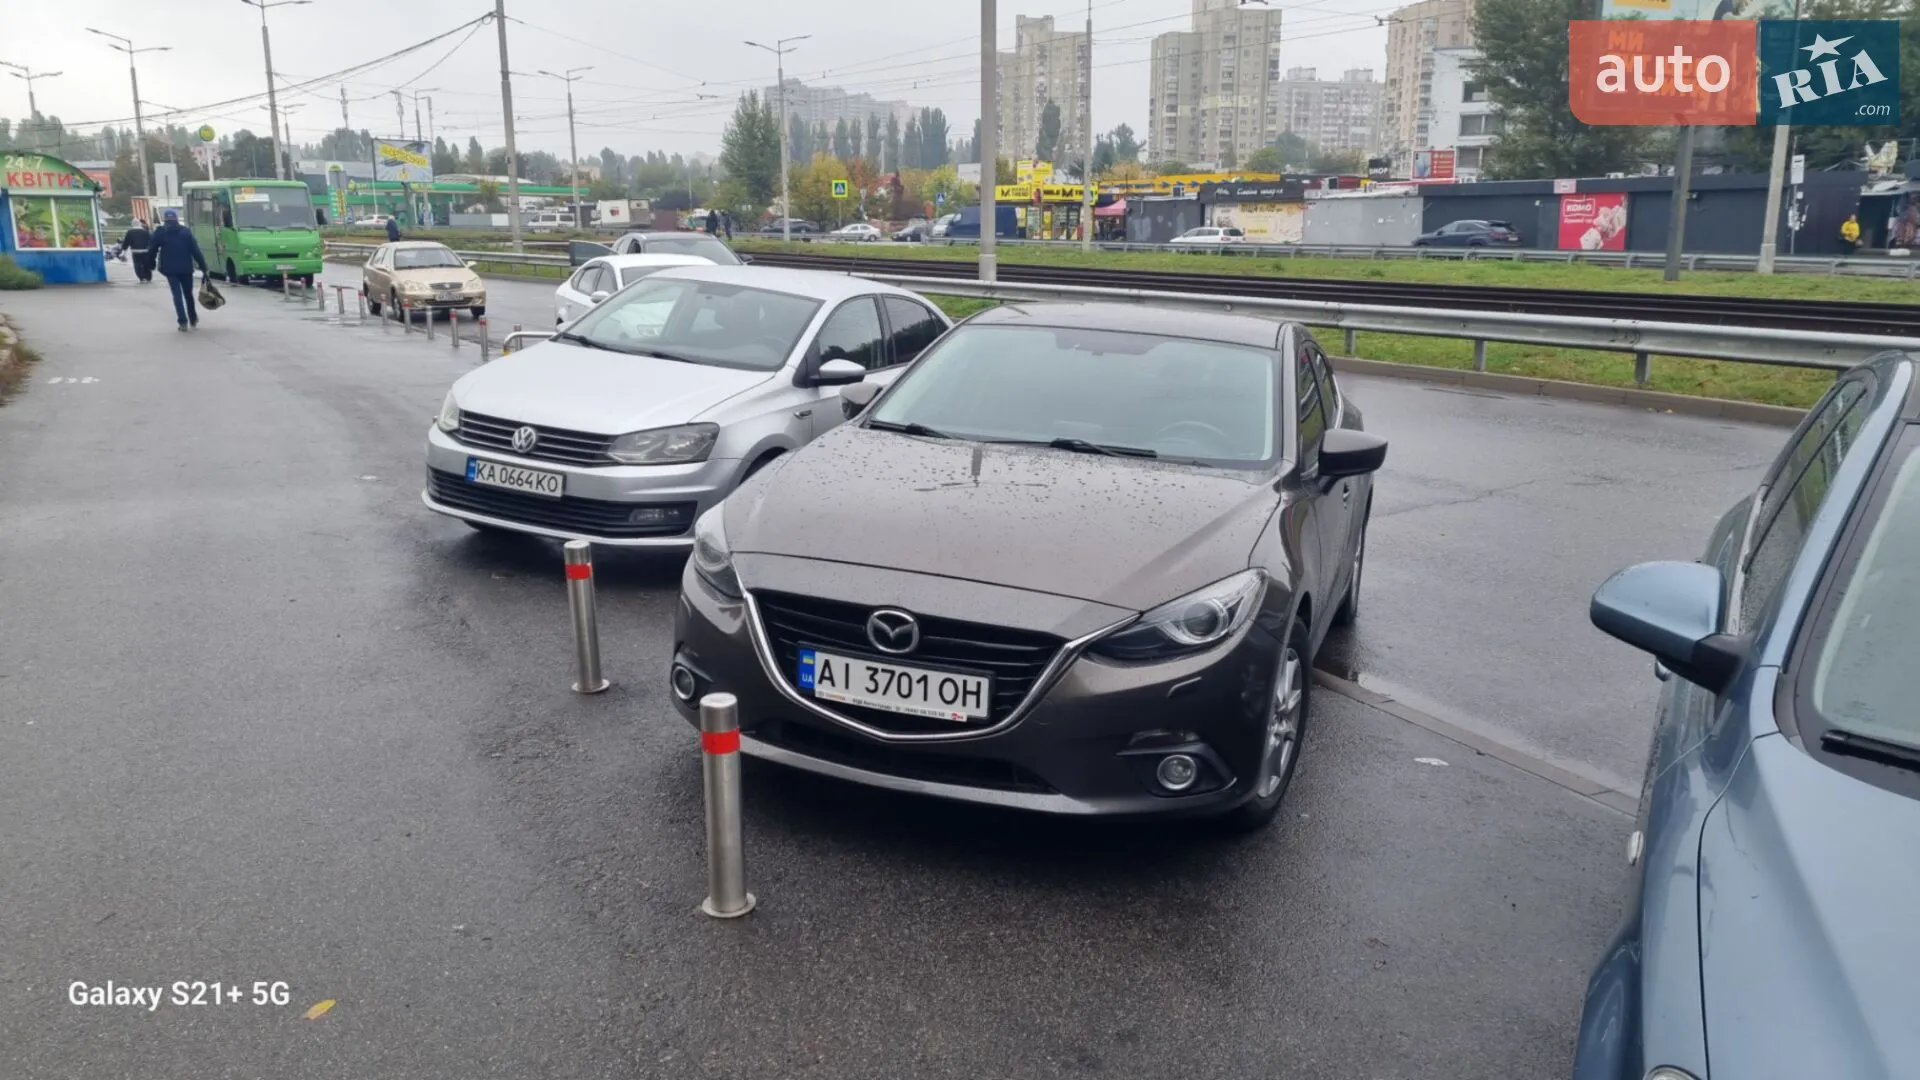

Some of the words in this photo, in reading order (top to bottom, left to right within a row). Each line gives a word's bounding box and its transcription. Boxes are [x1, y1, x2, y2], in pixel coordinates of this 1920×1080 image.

[7, 171, 72, 188] КВІТИ
[476, 462, 496, 483] KA
[499, 467, 533, 489] 0664
[535, 472, 558, 493] KO
[801, 673, 814, 684] UA
[817, 658, 850, 690] AI
[864, 665, 928, 702] 3701
[938, 677, 982, 709] OH
